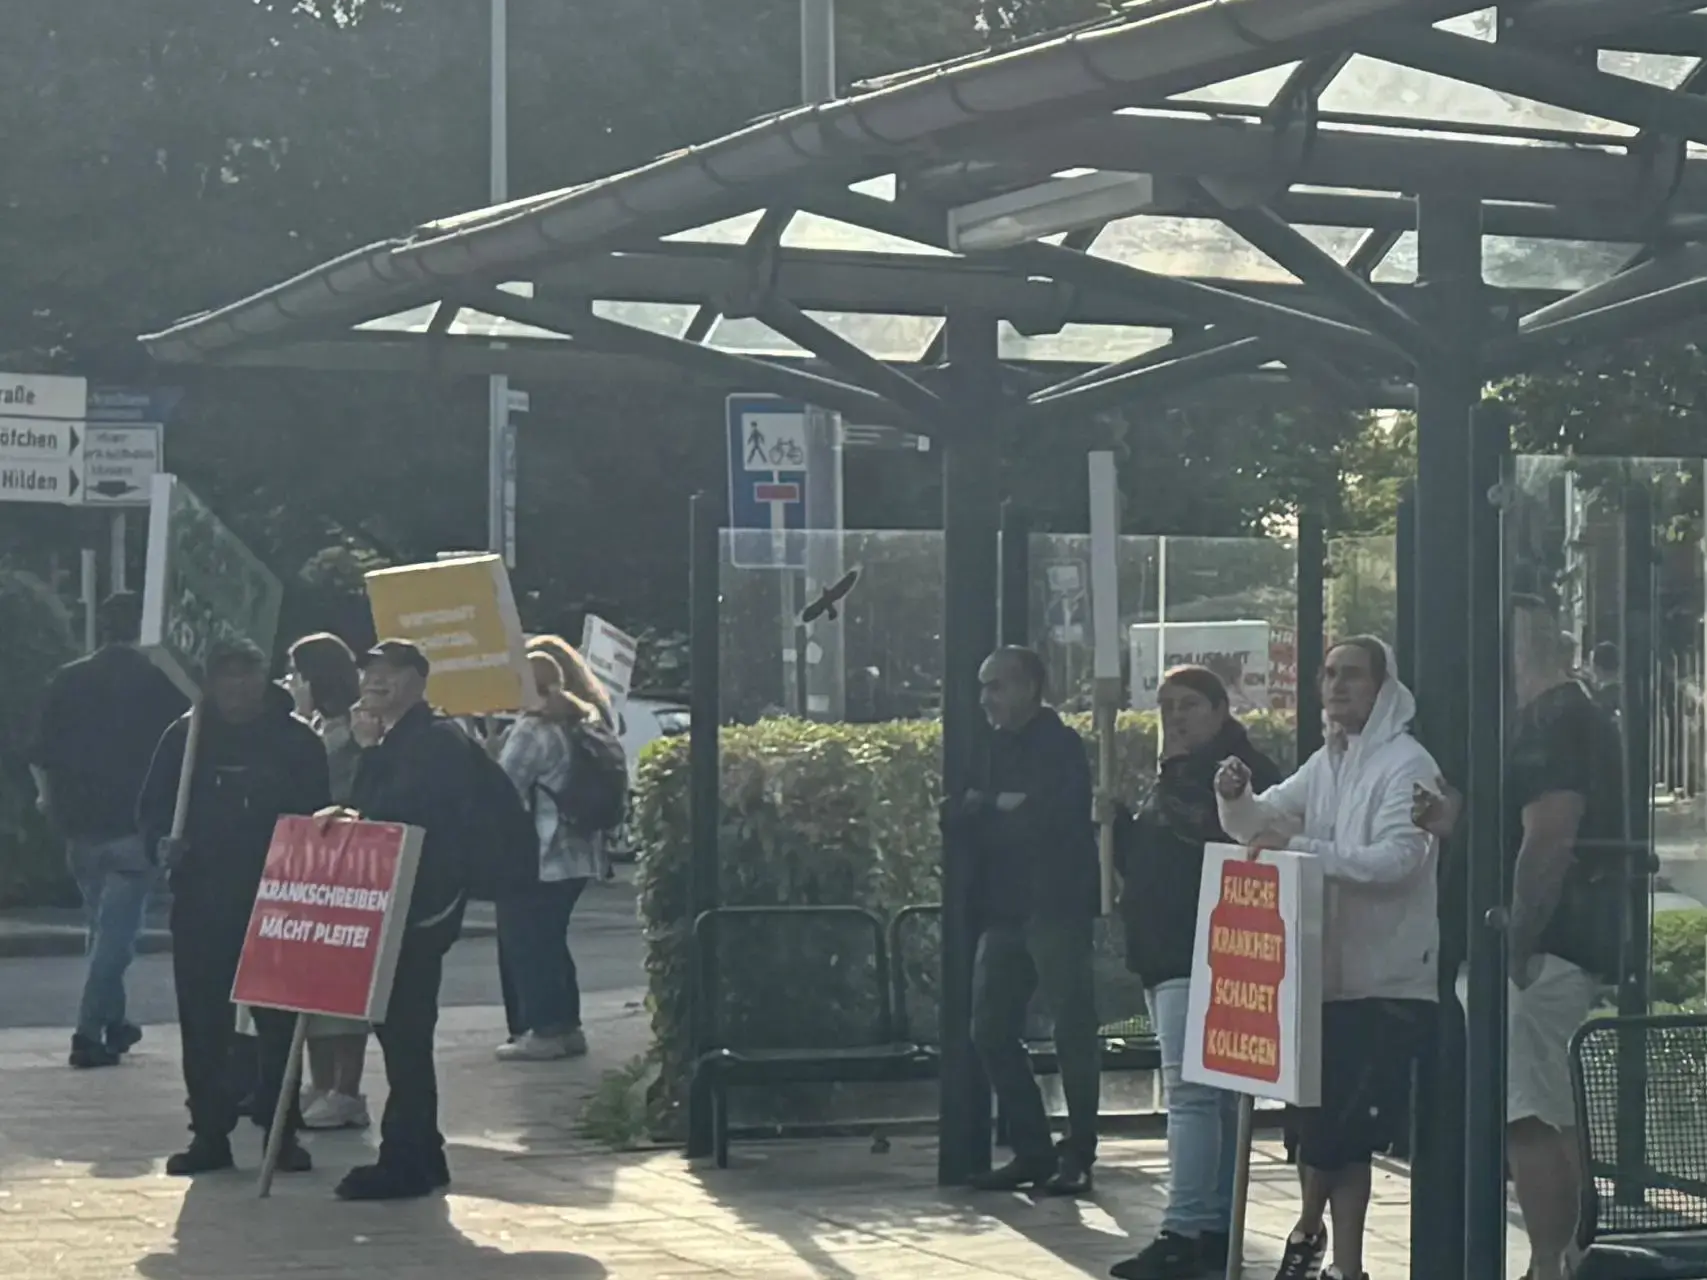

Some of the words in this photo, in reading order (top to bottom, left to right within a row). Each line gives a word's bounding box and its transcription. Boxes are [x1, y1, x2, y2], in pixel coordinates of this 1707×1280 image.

[2, 467, 58, 492] Hilden
[257, 879, 390, 912] KRANKSCHREIBEN
[1223, 875, 1277, 910] FALSCHE
[258, 915, 314, 942] MACHT
[313, 922, 371, 949] PLEITE!
[1211, 925, 1283, 964] KRANKHEIT
[1215, 976, 1276, 1014] SCHADET
[1206, 1028, 1277, 1067] KOLLEGEN
